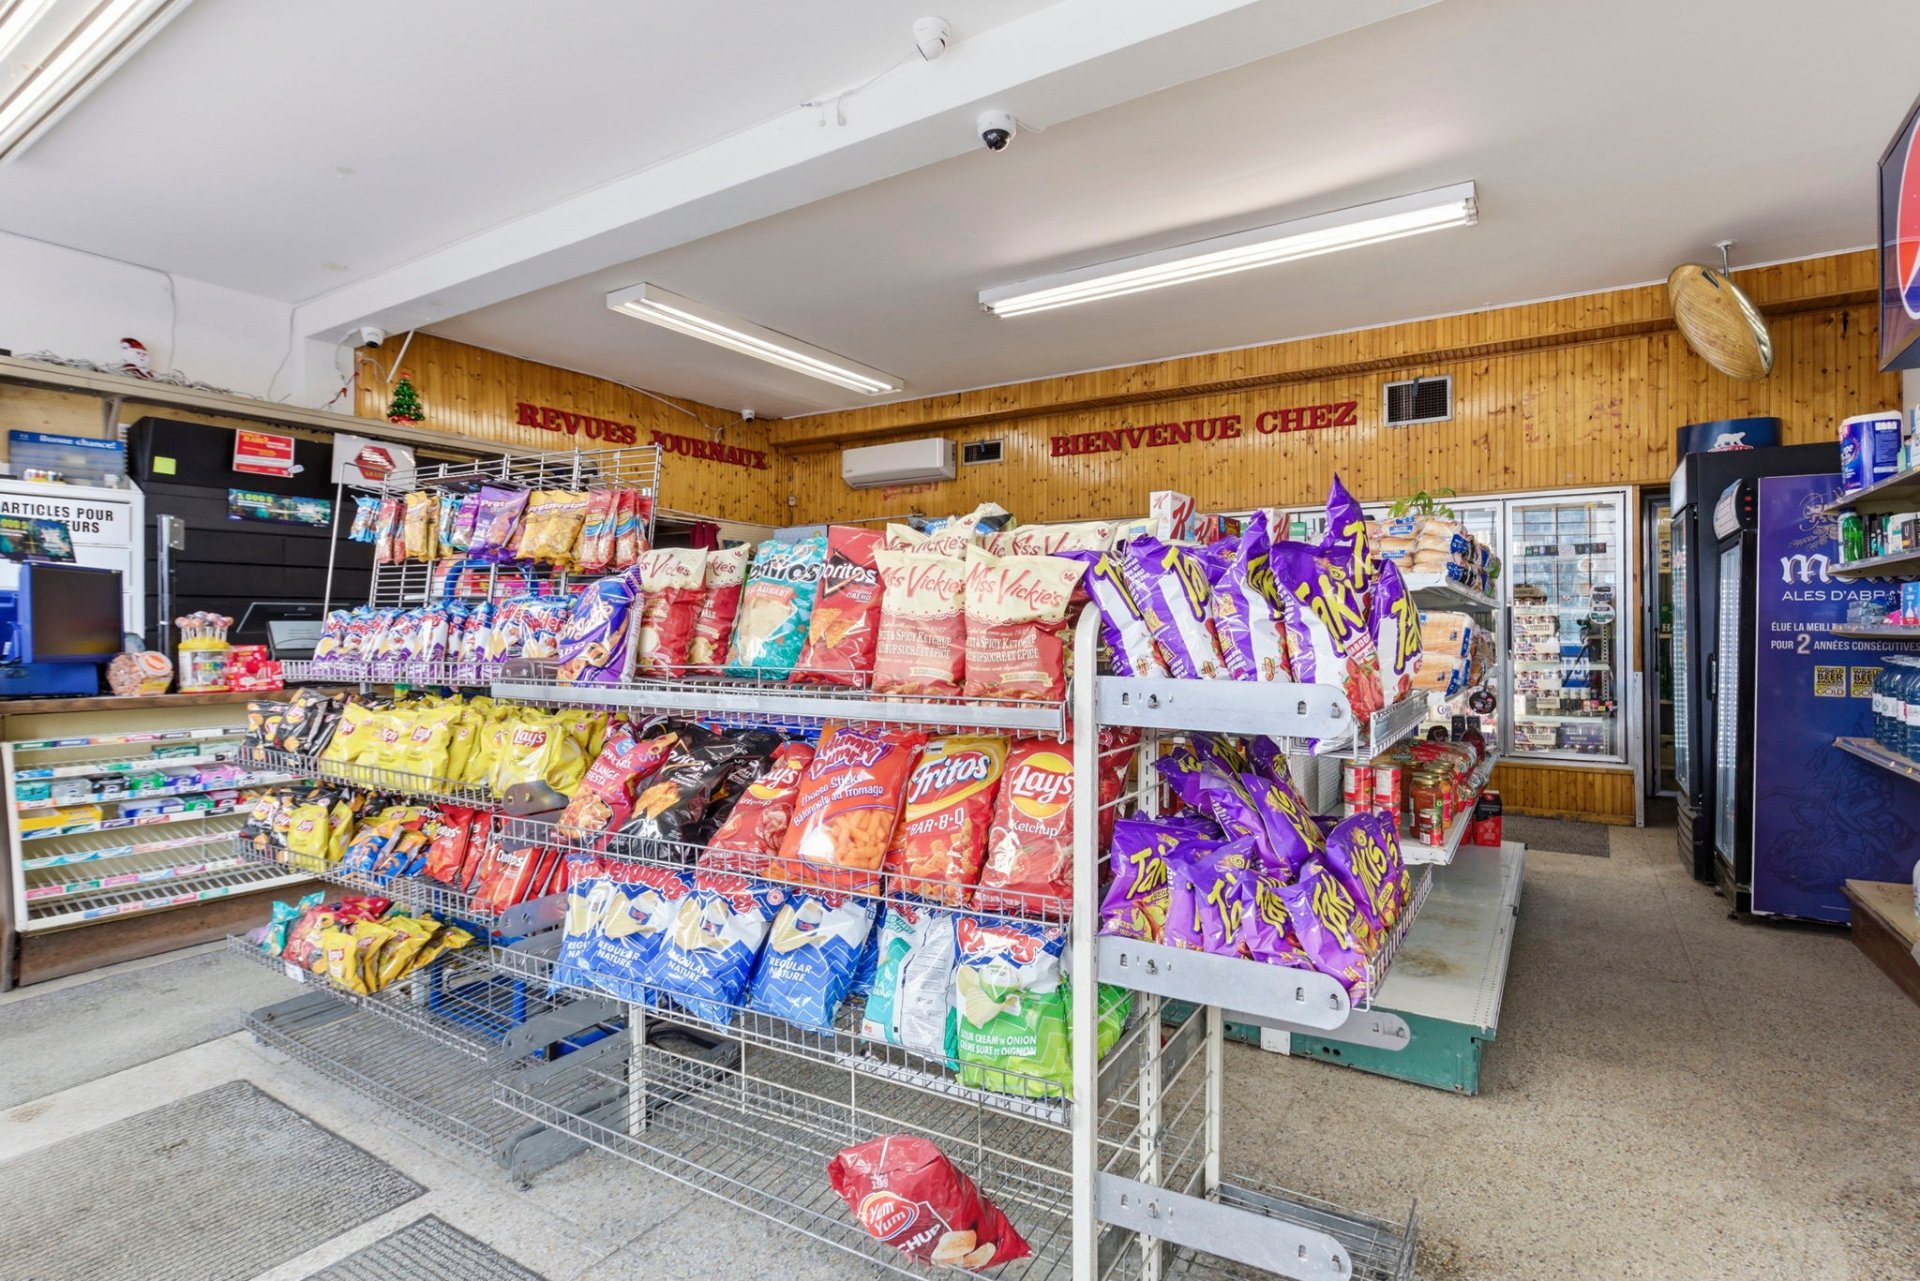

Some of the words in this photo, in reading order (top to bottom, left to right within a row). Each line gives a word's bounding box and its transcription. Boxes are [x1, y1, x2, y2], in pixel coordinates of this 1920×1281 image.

[516, 402, 637, 445] REVUES
[648, 430, 768, 470] JOURNAUX
[1050, 415, 1241, 457] BIENVENUE
[1255, 401, 1358, 434] CHEZ
[1, 501, 70, 518] ARTICLES
[77, 507, 114, 521] POUR
[905, 563, 965, 601] Vickie's
[966, 562, 997, 603] Miss
[997, 568, 1064, 612] Vickie's
[1782, 590, 1822, 601] ALES
[1771, 620, 1792, 632] ÉLUE
[1794, 622, 1804, 632] LA
[1770, 639, 1794, 650] POUR
[1796, 633, 1811, 654] 2
[1814, 638, 1850, 651] ANNÉES
[1852, 638, 1920, 652] CONSÉCUTIVES
[1815, 687, 1844, 696] GOLD
[909, 753, 992, 804] Fritos
[1012, 763, 1074, 804] Lay's
[844, 785, 884, 797] fromage
[1011, 818, 1060, 838] Ketchup
[598, 939, 641, 962] REGULAR
[598, 951, 633, 969] NATURE
[668, 960, 701, 983] NATURE
[768, 956, 813, 973] REGULAR
[976, 1033, 998, 1045] CREAM
[1007, 1035, 1037, 1046] ONION
[976, 1043, 993, 1054] SURE
[1001, 1046, 1037, 1056] OIGNON
[869, 1201, 895, 1224] Yum
[874, 1211, 906, 1236] Yum
